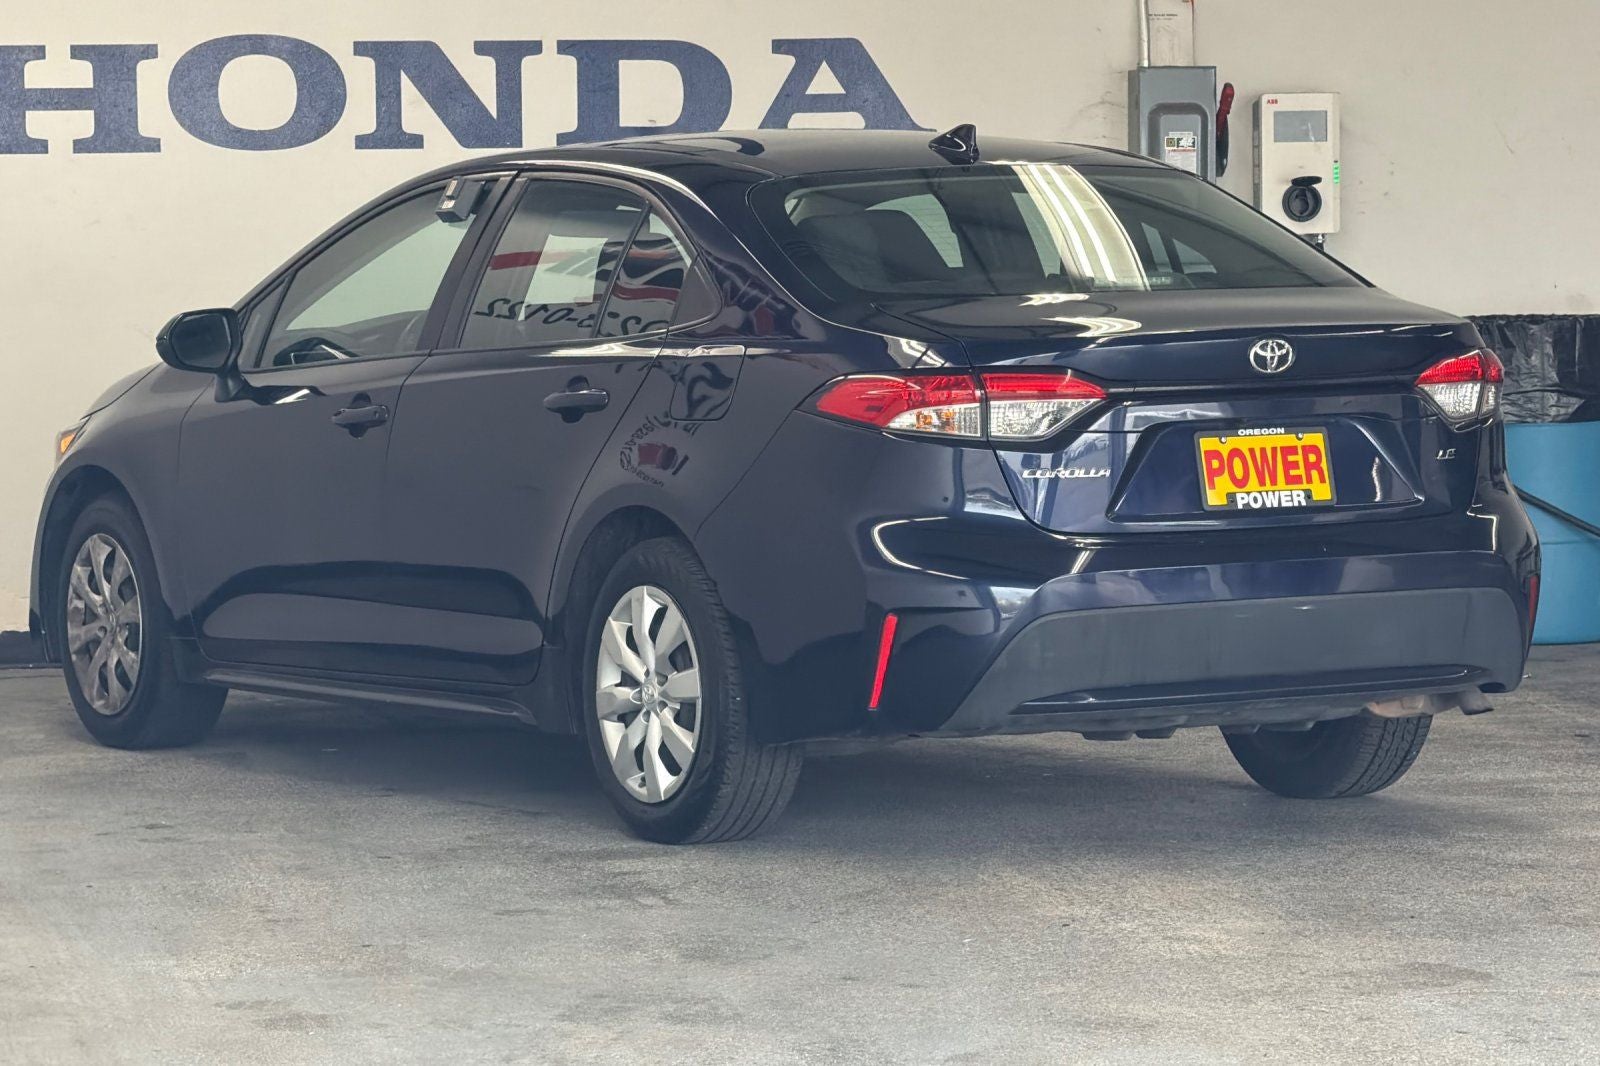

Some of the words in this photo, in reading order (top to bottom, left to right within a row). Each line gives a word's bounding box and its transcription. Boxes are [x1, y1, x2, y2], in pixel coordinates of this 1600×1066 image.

[0, 34, 937, 154] HONDA
[1237, 427, 1285, 436] OREGON
[1022, 467, 1111, 479] COROLLA
[1204, 444, 1327, 491] POWER
[1235, 489, 1307, 510] POWER
